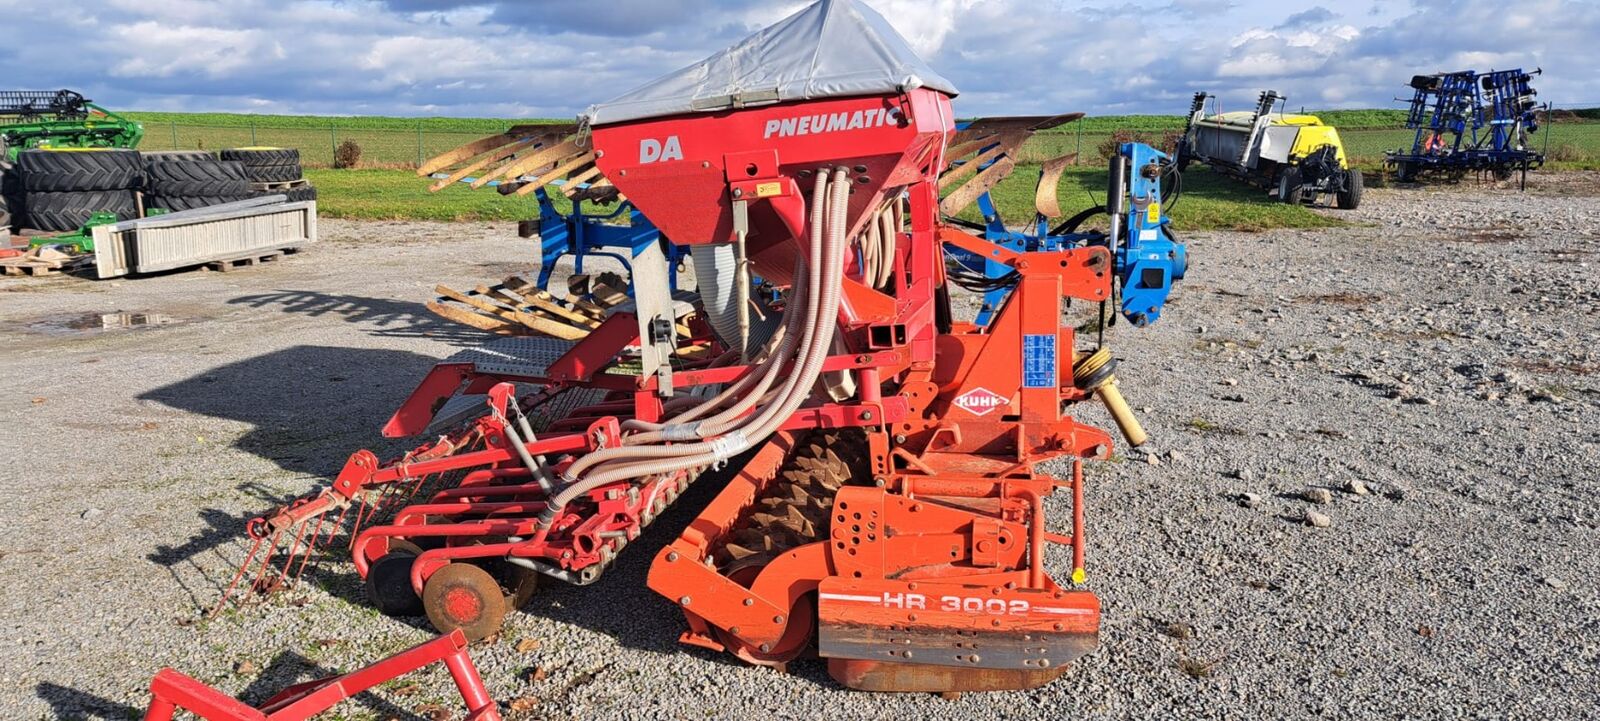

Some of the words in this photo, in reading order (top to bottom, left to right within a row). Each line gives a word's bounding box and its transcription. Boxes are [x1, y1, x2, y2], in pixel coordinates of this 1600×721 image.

[763, 106, 901, 139] PNEUMATIC
[639, 135, 684, 164] DA
[883, 592, 926, 610] HR
[940, 595, 1030, 616] 3002
